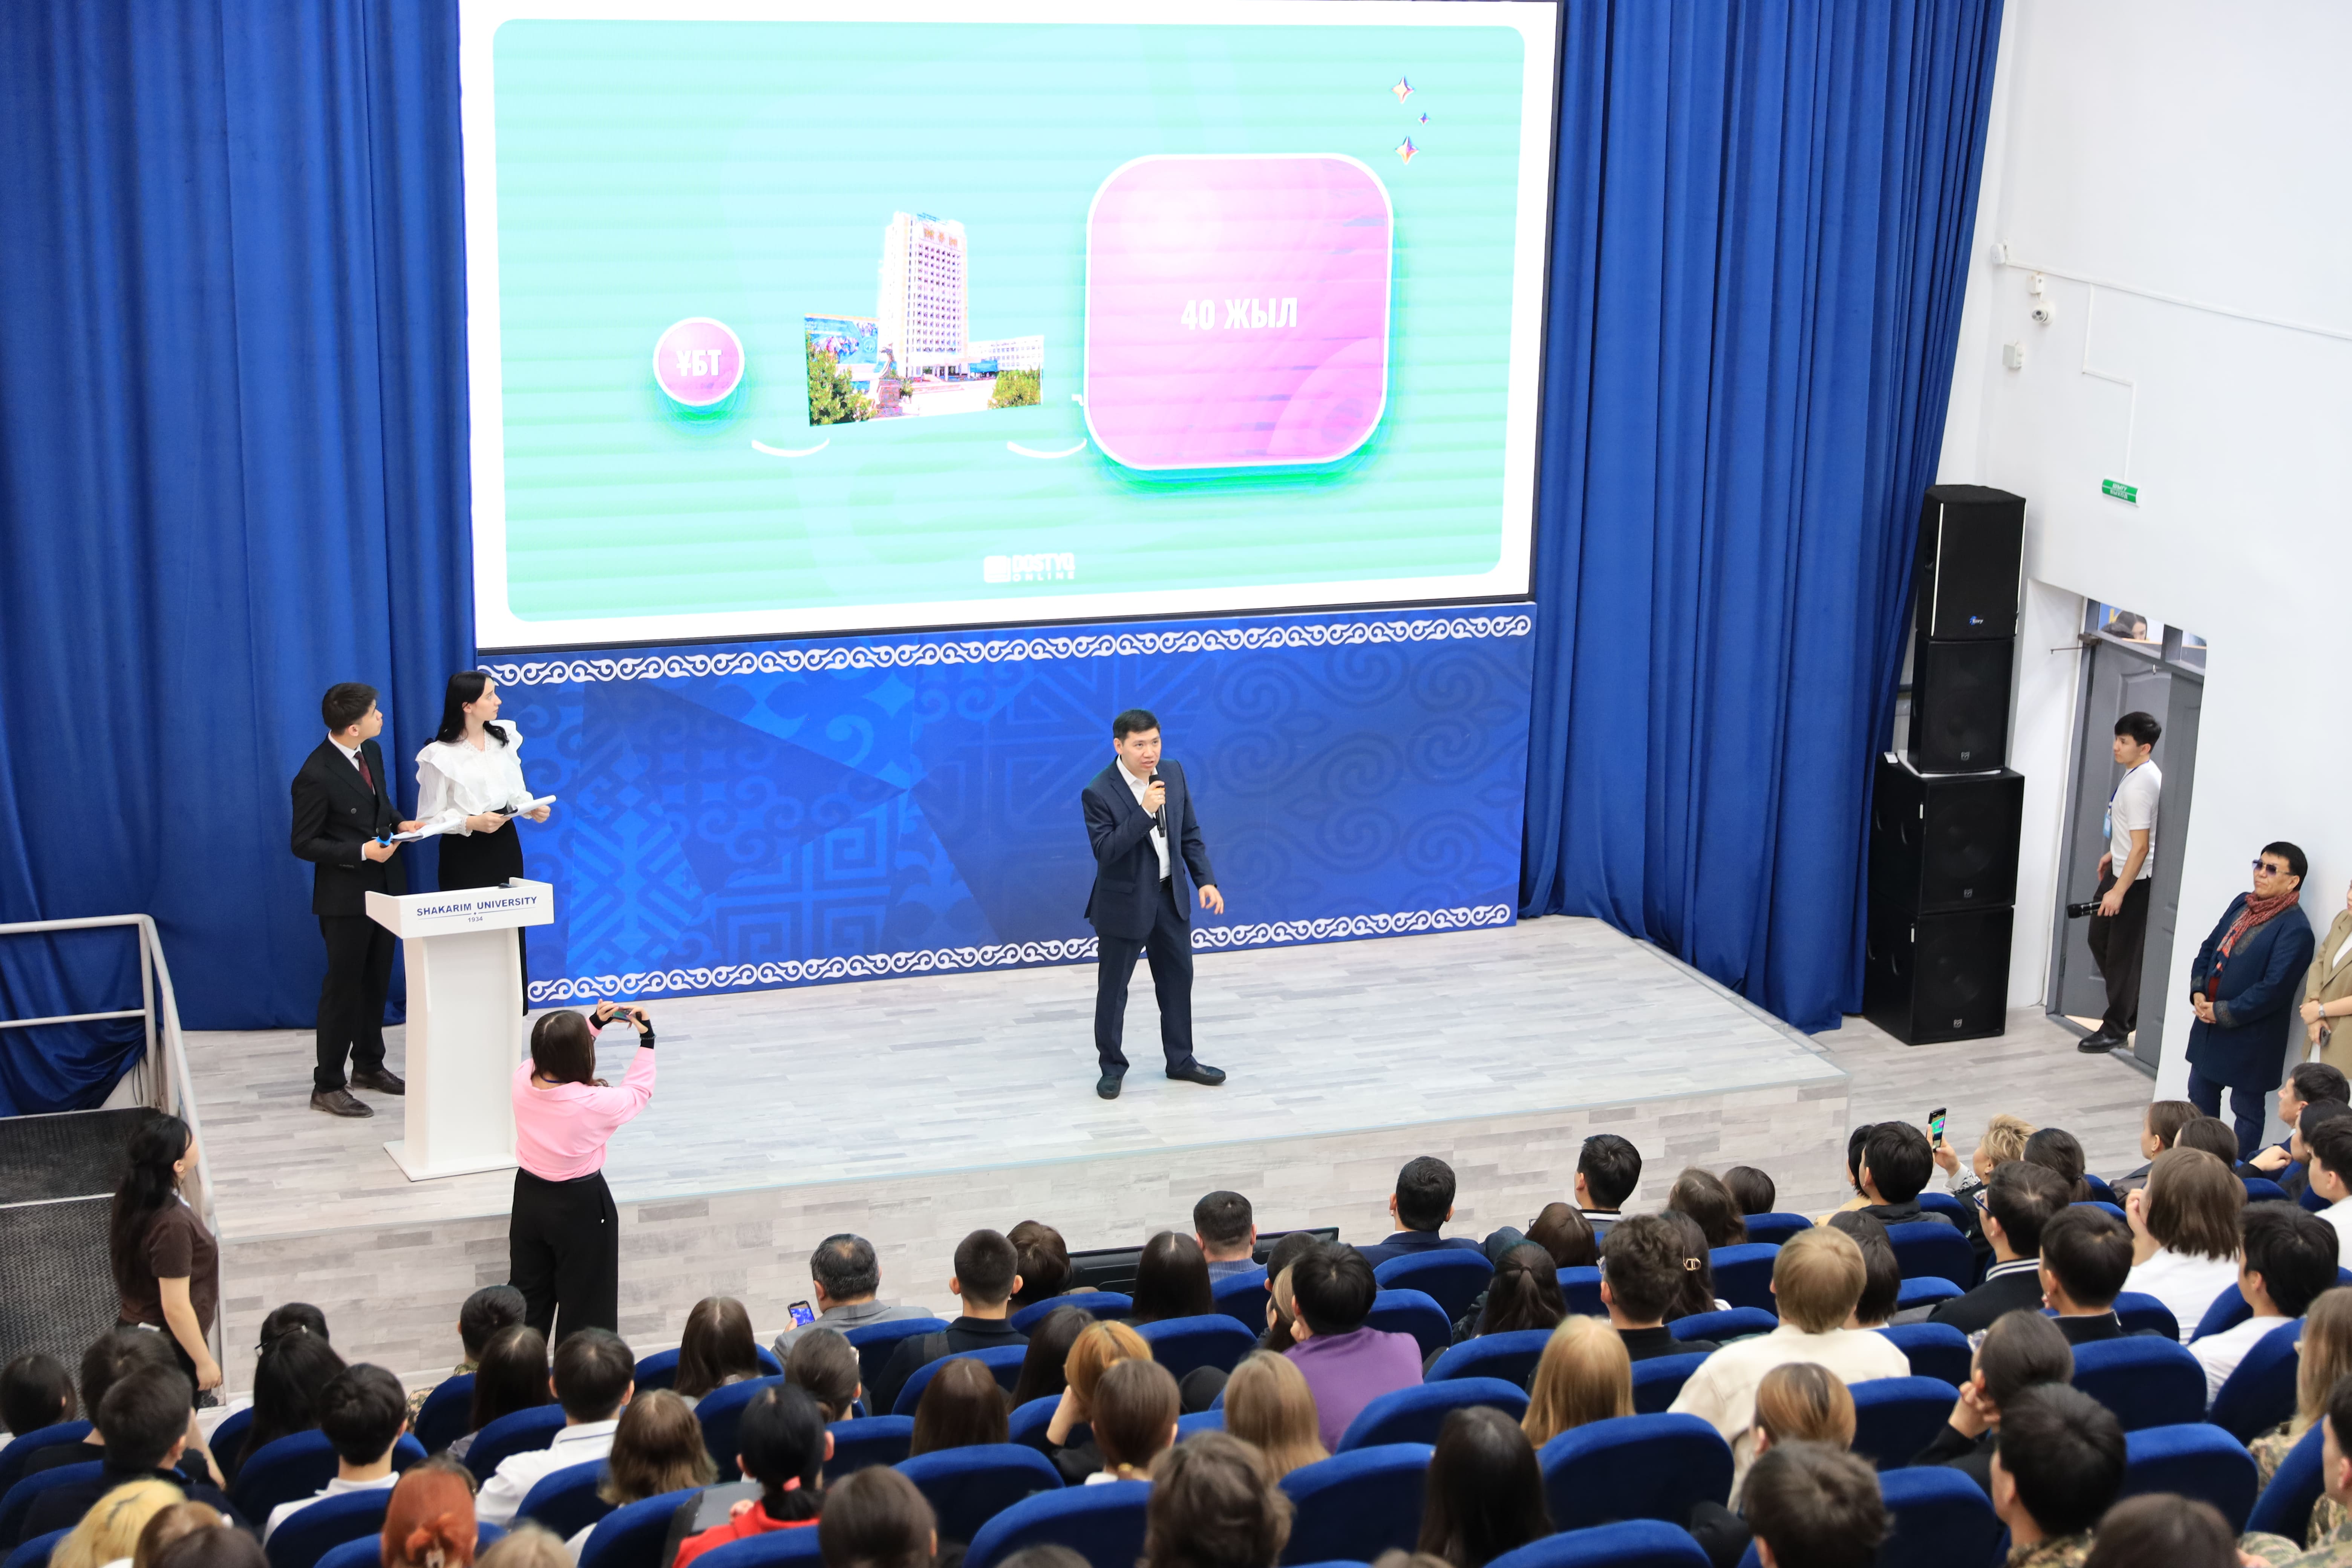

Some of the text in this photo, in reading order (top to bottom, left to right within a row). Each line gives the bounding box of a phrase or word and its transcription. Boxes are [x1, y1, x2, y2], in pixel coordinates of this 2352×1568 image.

[1181, 297, 1298, 330] 40 ЖЫЛ
[676, 349, 722, 377] ҰБТ
[1012, 553, 1076, 573] DOSTYQ
[1012, 571, 1075, 582] ONLINE
[417, 896, 537, 916] SHAKARIM UNIVERSITY
